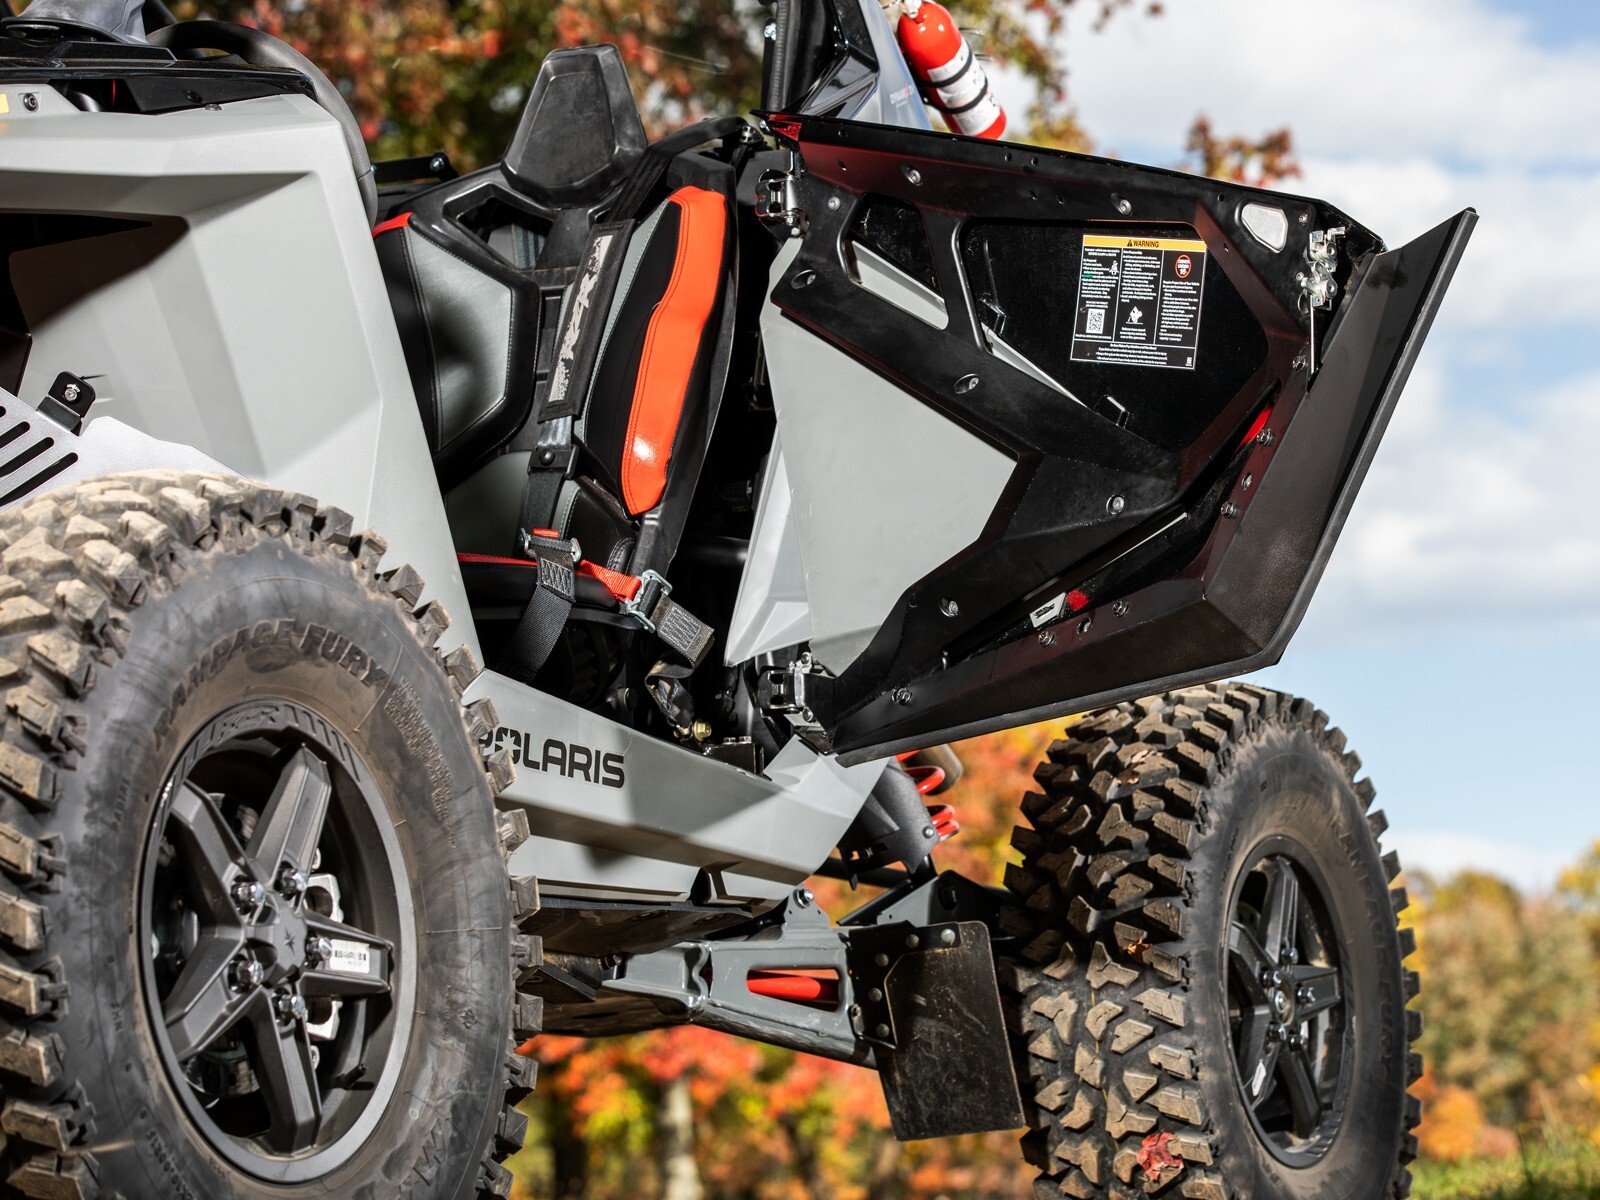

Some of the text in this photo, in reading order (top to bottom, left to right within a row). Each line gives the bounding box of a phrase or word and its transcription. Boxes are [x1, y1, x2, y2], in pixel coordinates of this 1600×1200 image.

[1133, 239, 1160, 248] WARNING
[153, 618, 390, 751] RAMPAGE FURY
